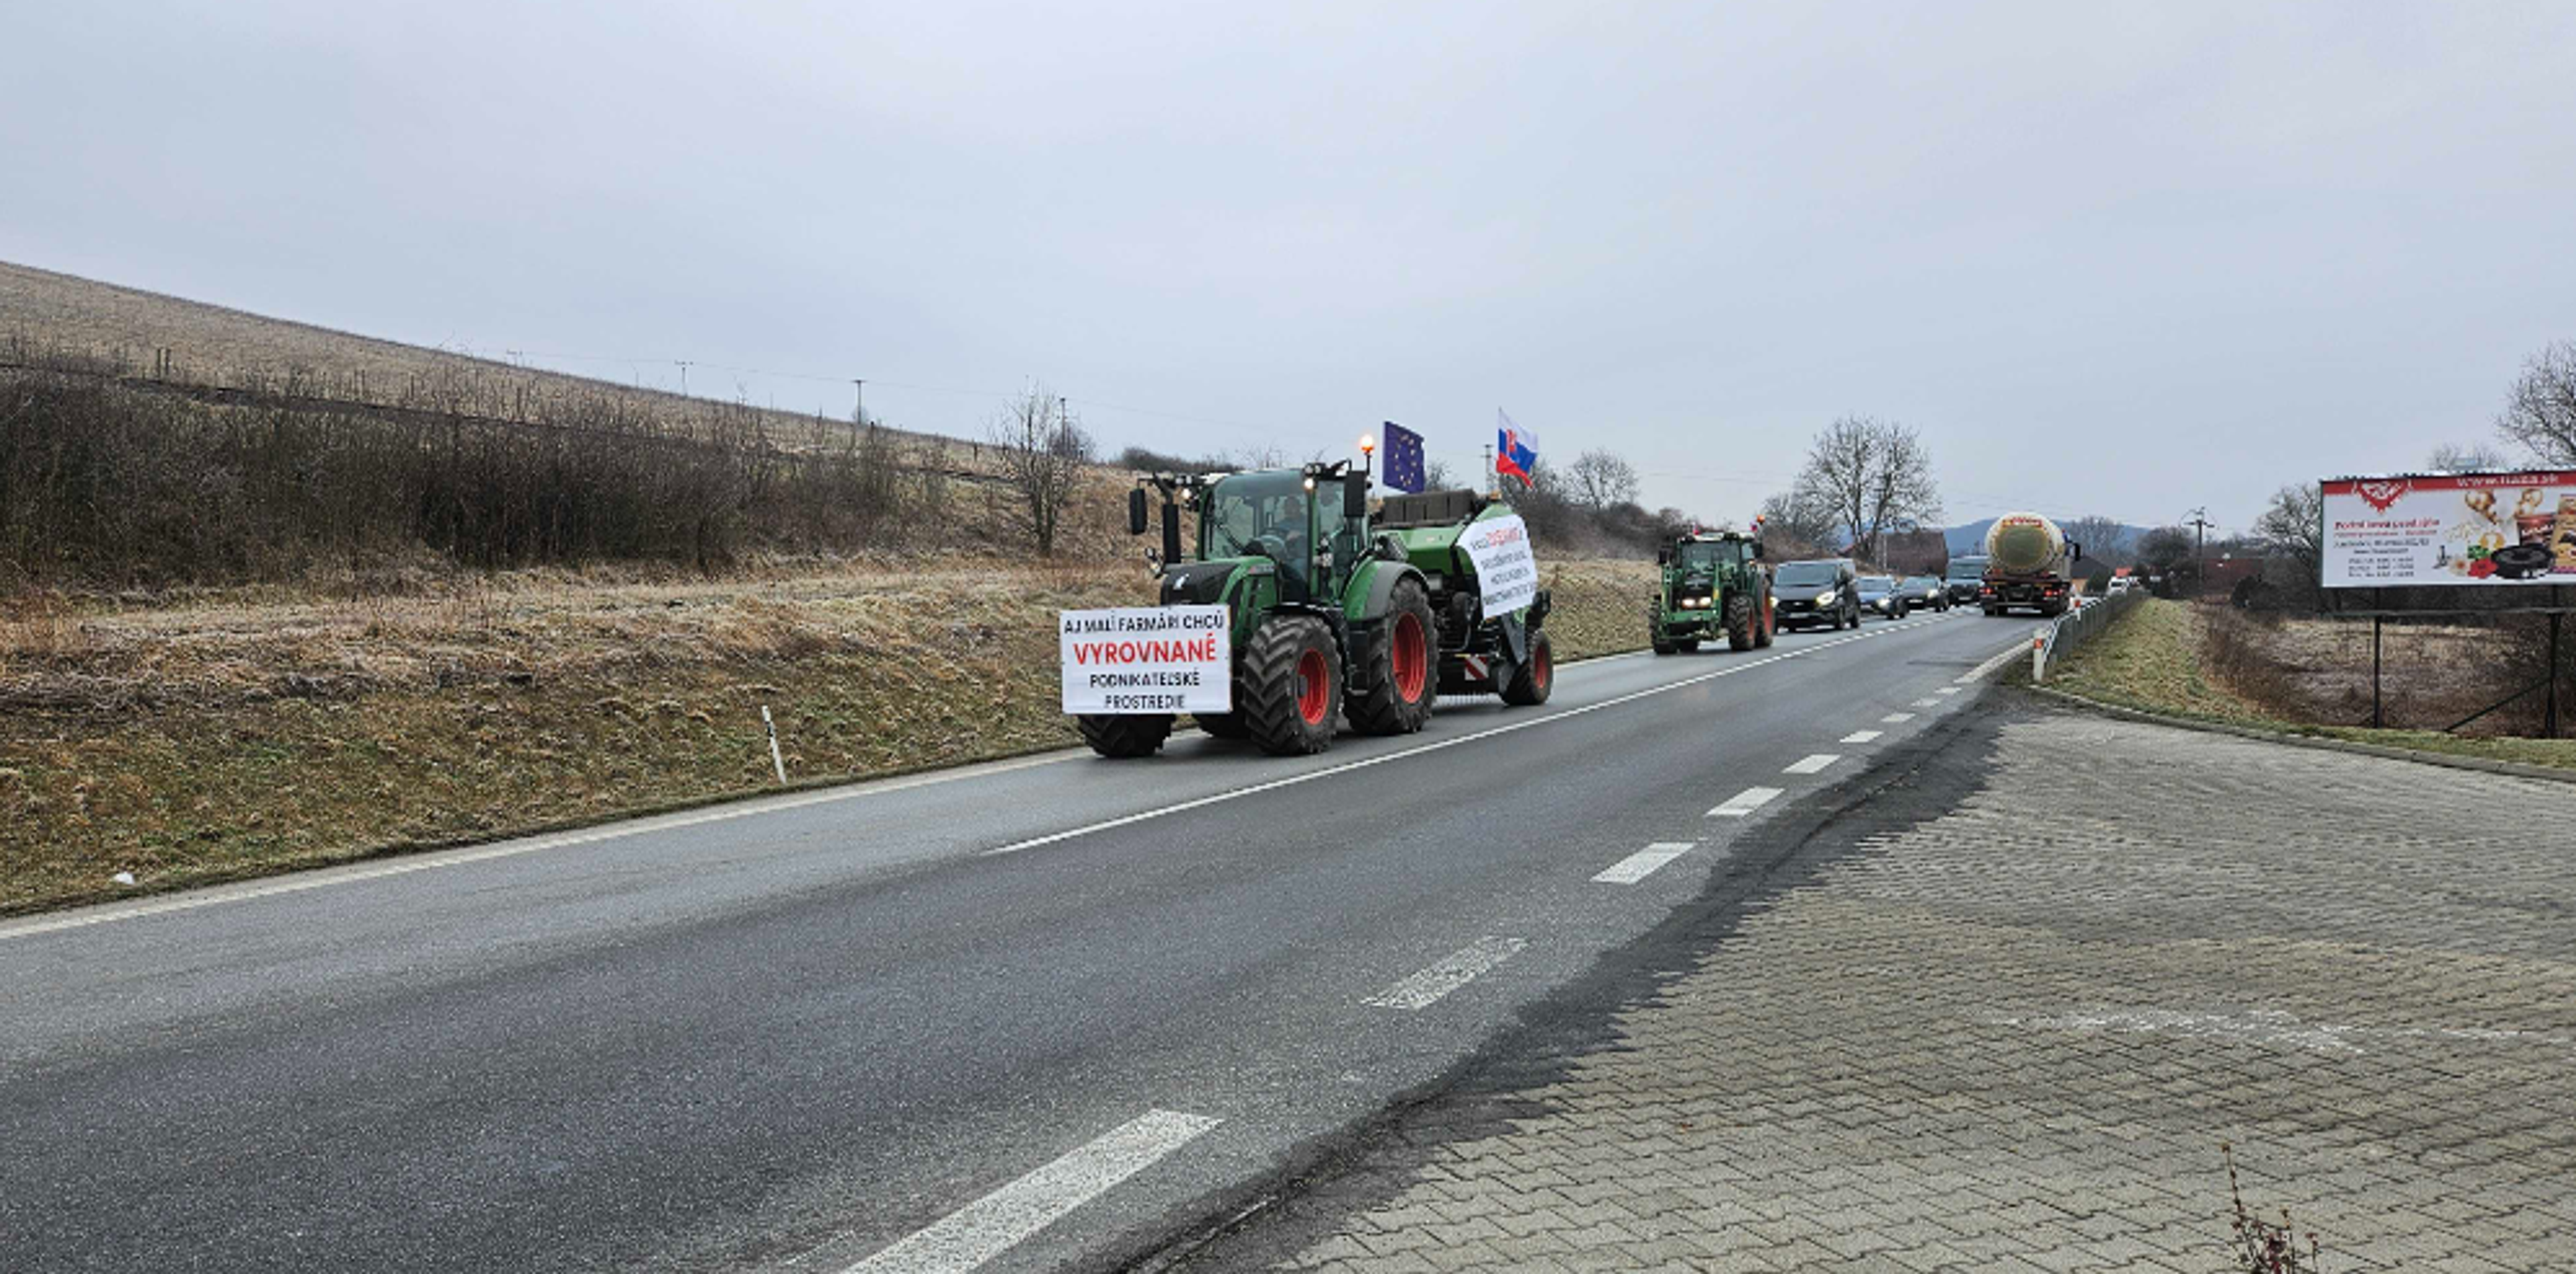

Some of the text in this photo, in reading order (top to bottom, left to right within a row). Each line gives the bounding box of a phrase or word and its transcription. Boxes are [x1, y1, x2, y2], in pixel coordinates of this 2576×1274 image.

[1064, 610, 1224, 634] AJ MALÍ FARMÁRI CHCÚ
[1073, 632, 1217, 665] VYROVNANÉ
[1090, 668, 1200, 689] PODNIKATEĽSKÉ
[1104, 695, 1186, 709] PROSTREDIE
